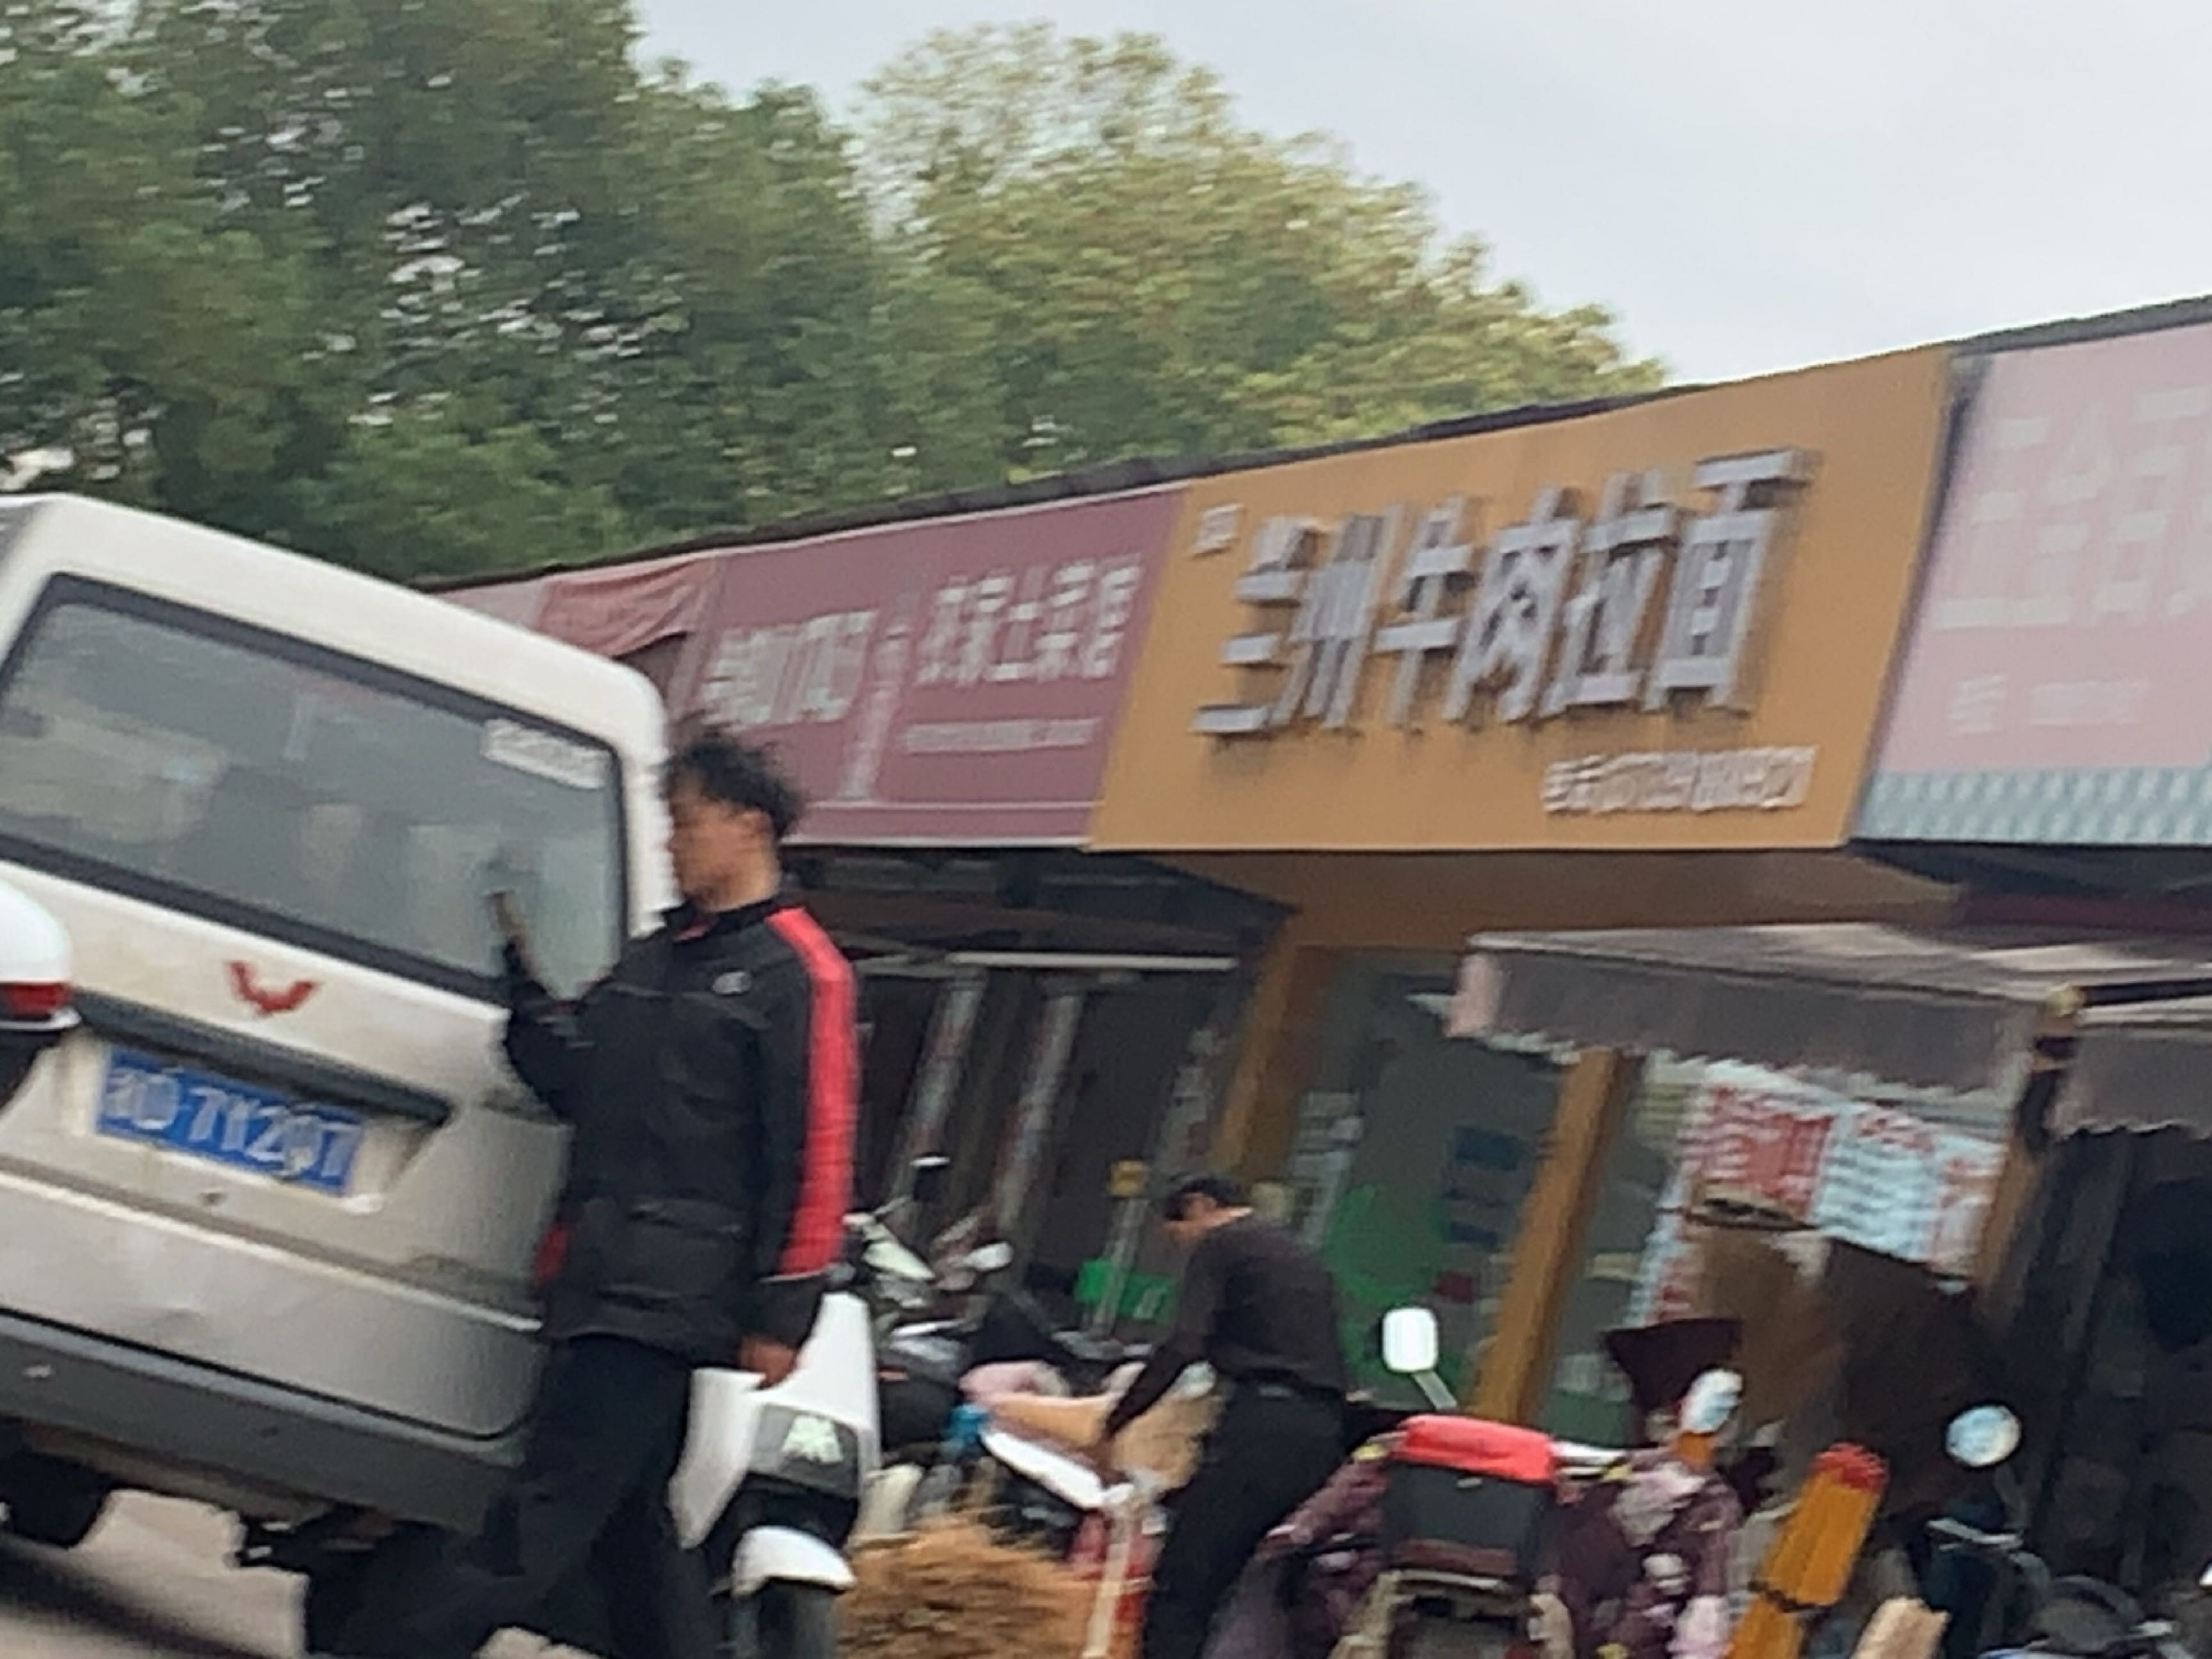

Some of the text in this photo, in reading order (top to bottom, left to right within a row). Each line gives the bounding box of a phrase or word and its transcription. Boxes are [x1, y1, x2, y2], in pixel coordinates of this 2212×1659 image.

[1192, 448, 1810, 734] 兰州牛肉拉面
